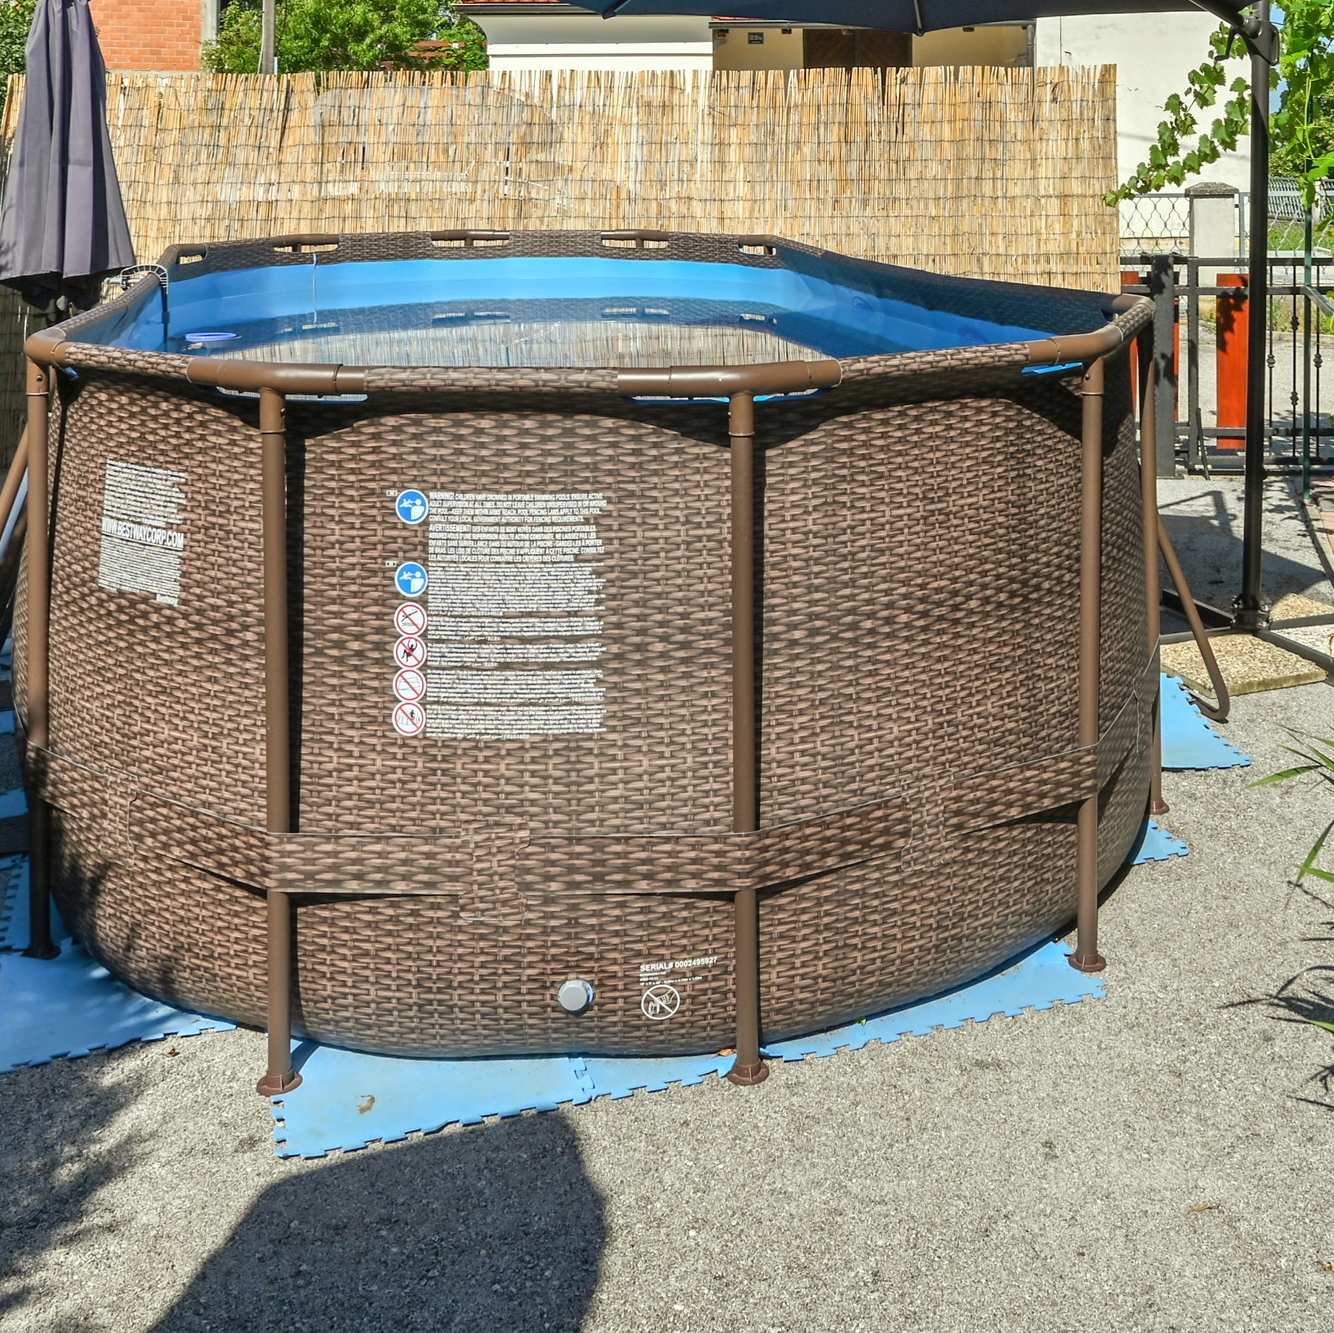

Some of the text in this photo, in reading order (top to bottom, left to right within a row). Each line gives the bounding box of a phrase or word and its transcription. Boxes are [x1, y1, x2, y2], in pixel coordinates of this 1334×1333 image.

[102, 517, 185, 547] WWW.BESTWAYCORP.COM
[640, 956, 718, 972] SERIAL# 0002495927
